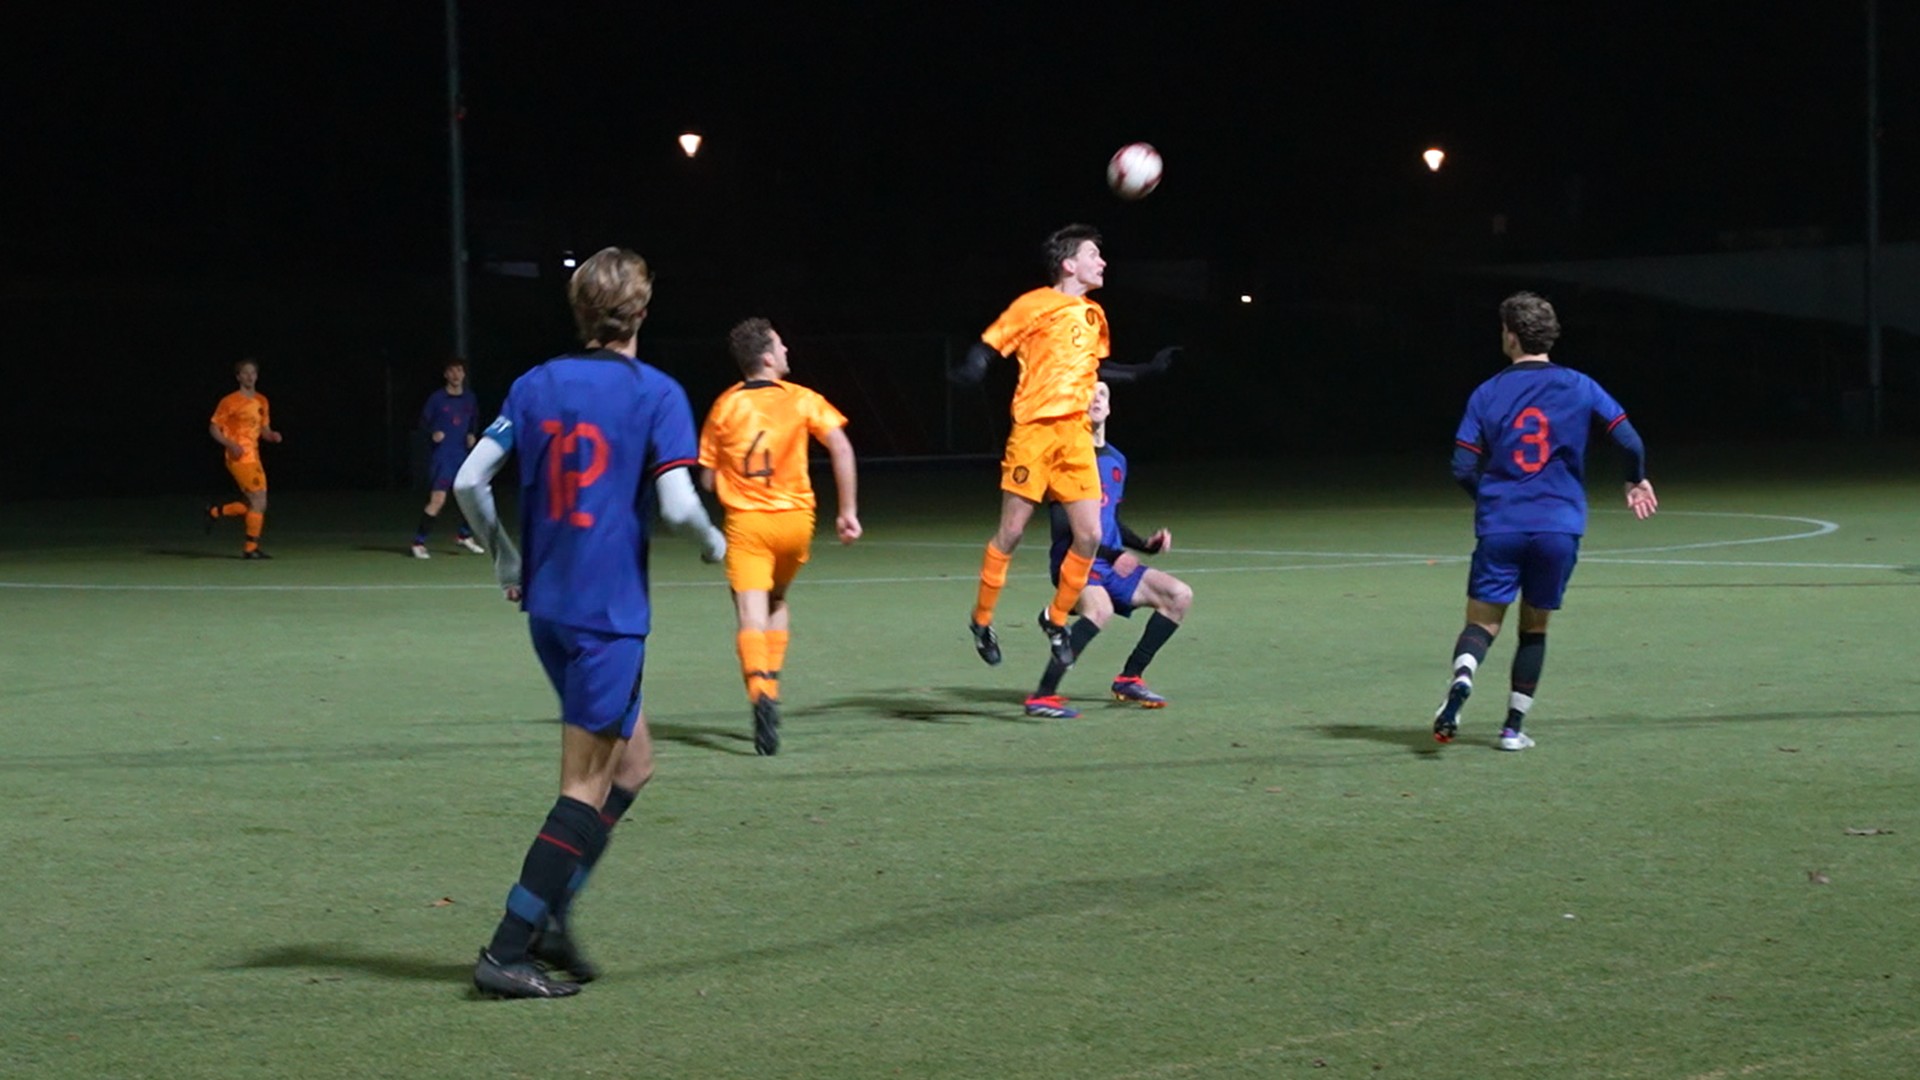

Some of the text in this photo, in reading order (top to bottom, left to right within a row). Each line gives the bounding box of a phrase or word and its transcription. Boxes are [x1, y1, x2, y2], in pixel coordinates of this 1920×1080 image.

[1071, 325, 1082, 348] 2
[743, 430, 774, 488] 4
[1512, 406, 1551, 473] 3
[542, 421, 609, 527] 12
